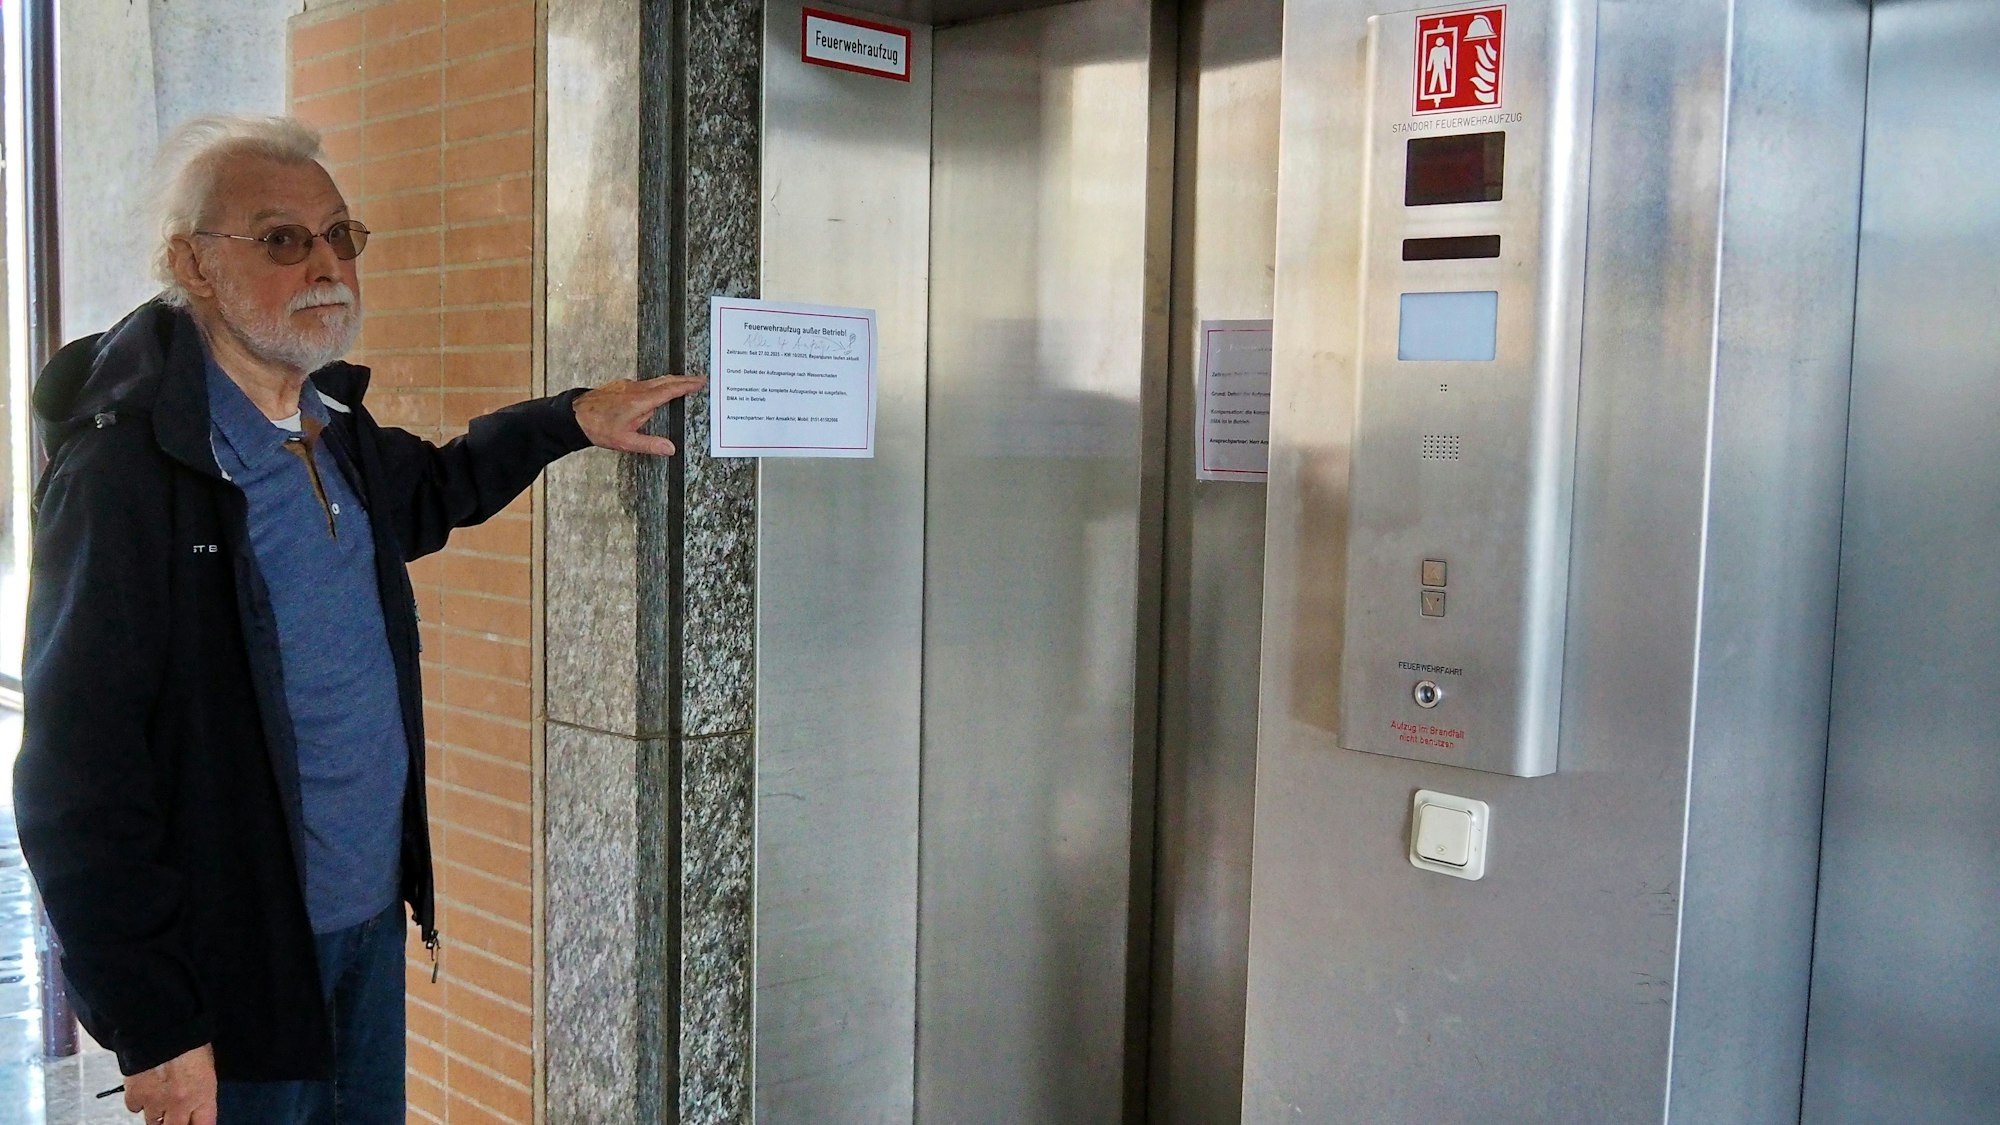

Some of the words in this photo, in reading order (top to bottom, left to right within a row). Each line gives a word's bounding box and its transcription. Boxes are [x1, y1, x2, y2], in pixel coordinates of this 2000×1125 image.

[815, 30, 898, 66] Feuerwehraufzug
[1392, 120, 1433, 133] STANDORT
[1435, 112, 1523, 129] FEUERWEHRAUFZUG
[743, 322, 801, 336] Feuerwehraufzug
[802, 326, 821, 335] außer
[822, 327, 847, 337] Betrieb!
[1398, 661, 1463, 676] FEUERWEHRFAHRT
[1391, 720, 1417, 733] Aufzug
[1418, 725, 1428, 733] im
[1429, 726, 1465, 740] Brandfall
[1399, 733, 1418, 744] nicht
[1420, 736, 1455, 749] benutzen
